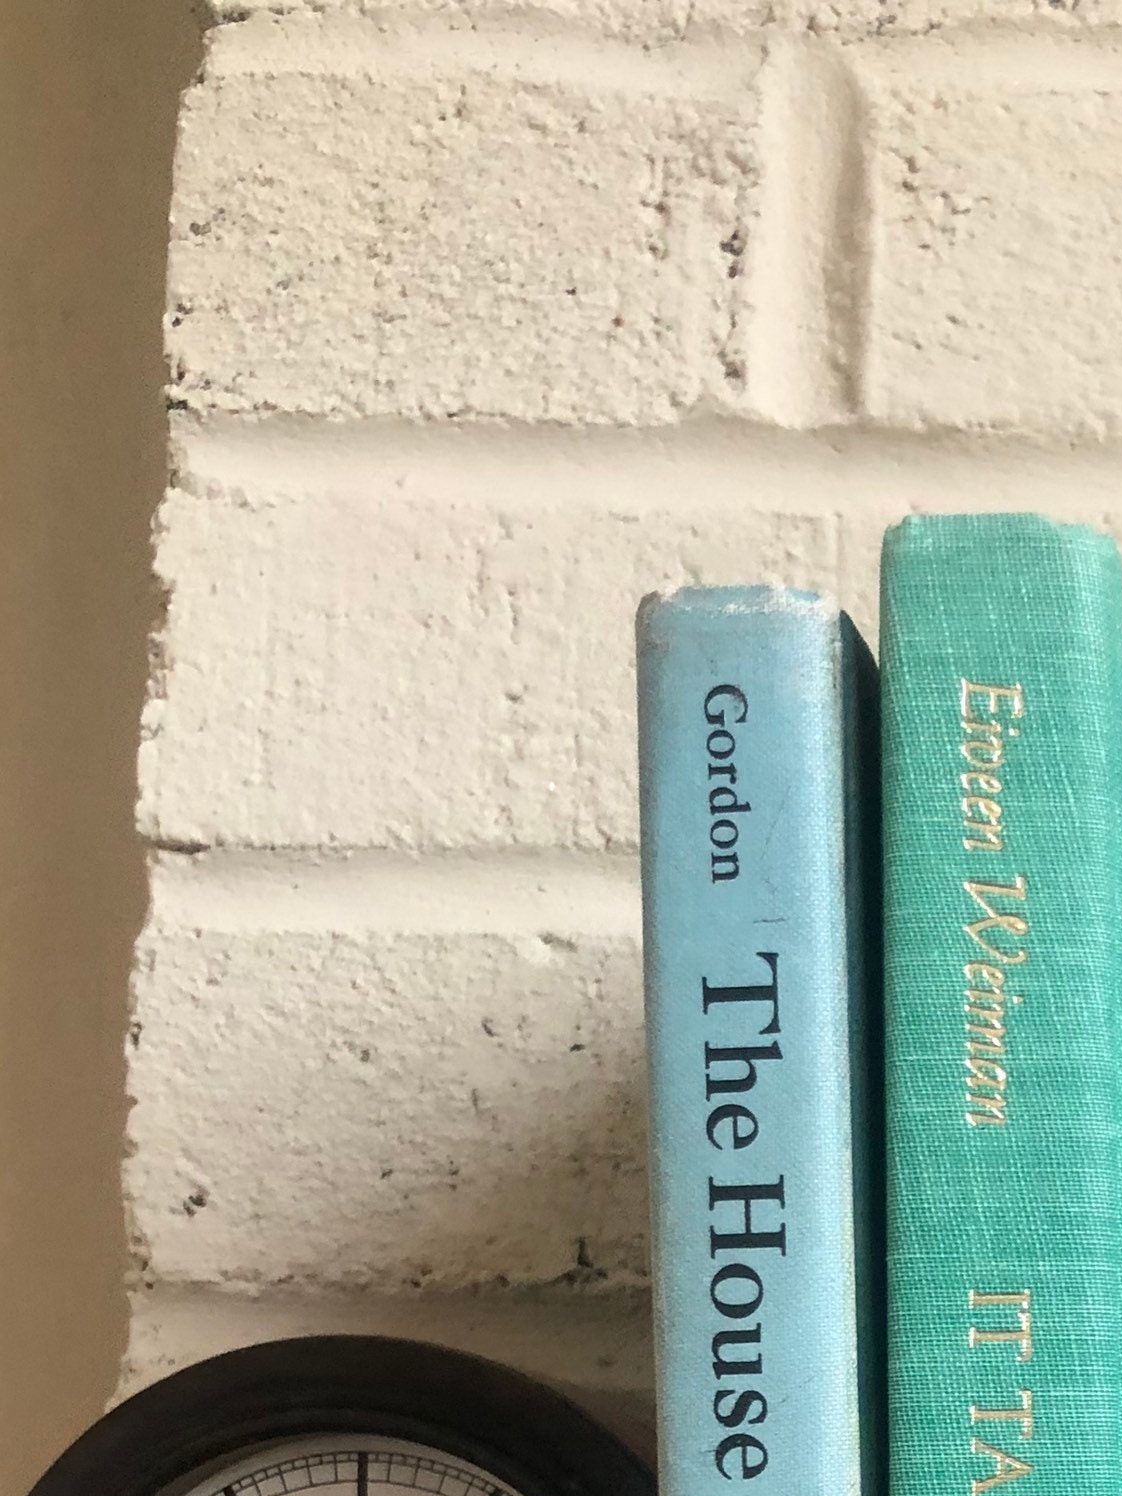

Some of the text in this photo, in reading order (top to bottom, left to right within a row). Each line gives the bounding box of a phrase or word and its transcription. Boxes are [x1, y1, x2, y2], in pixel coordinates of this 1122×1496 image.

[702, 683, 752, 885] Gordon
[960, 677, 1030, 1127] Eiveen Weiman
[701, 951, 785, 1151] The
[708, 1175, 787, 1481] House
[968, 1288, 1031, 1361] IT
